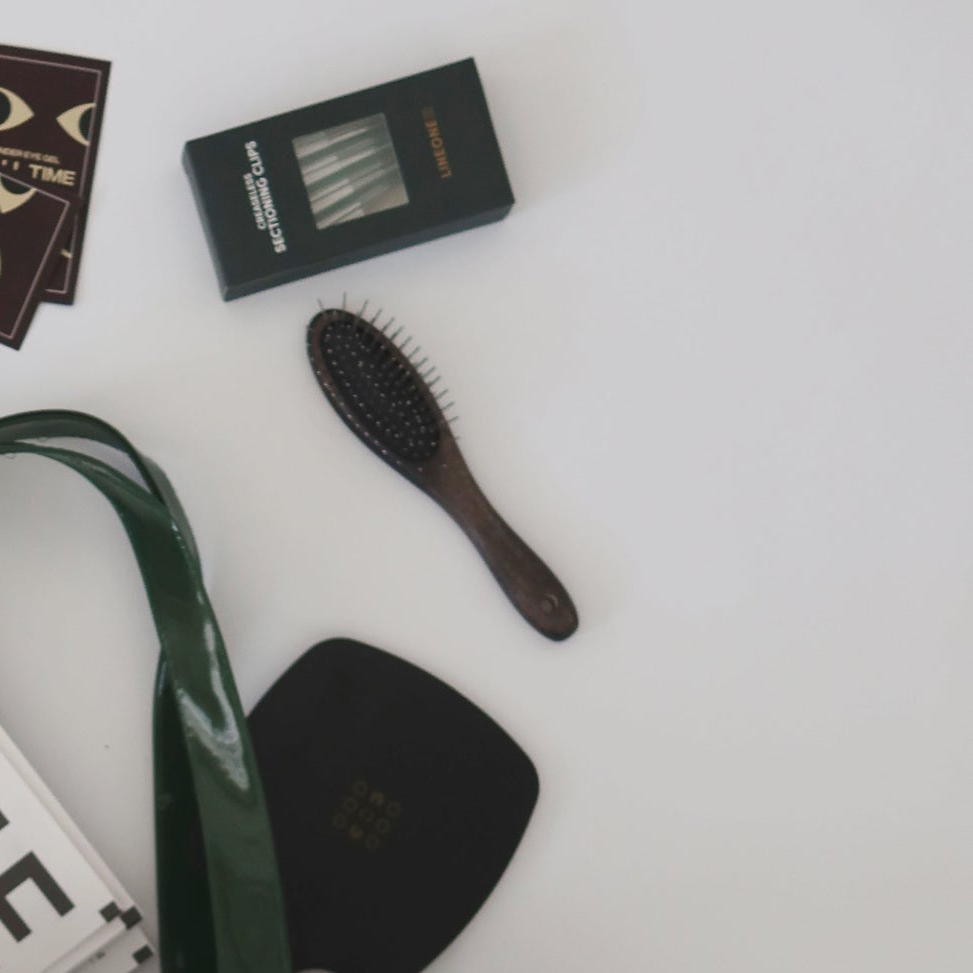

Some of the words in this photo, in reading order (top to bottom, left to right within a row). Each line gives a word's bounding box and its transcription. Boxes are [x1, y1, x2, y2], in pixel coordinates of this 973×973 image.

[245, 140, 265, 176] CLIPS
[425, 119, 452, 179] LINEONE
[28, 163, 77, 187] TIME
[258, 177, 287, 254] SECTIONING
